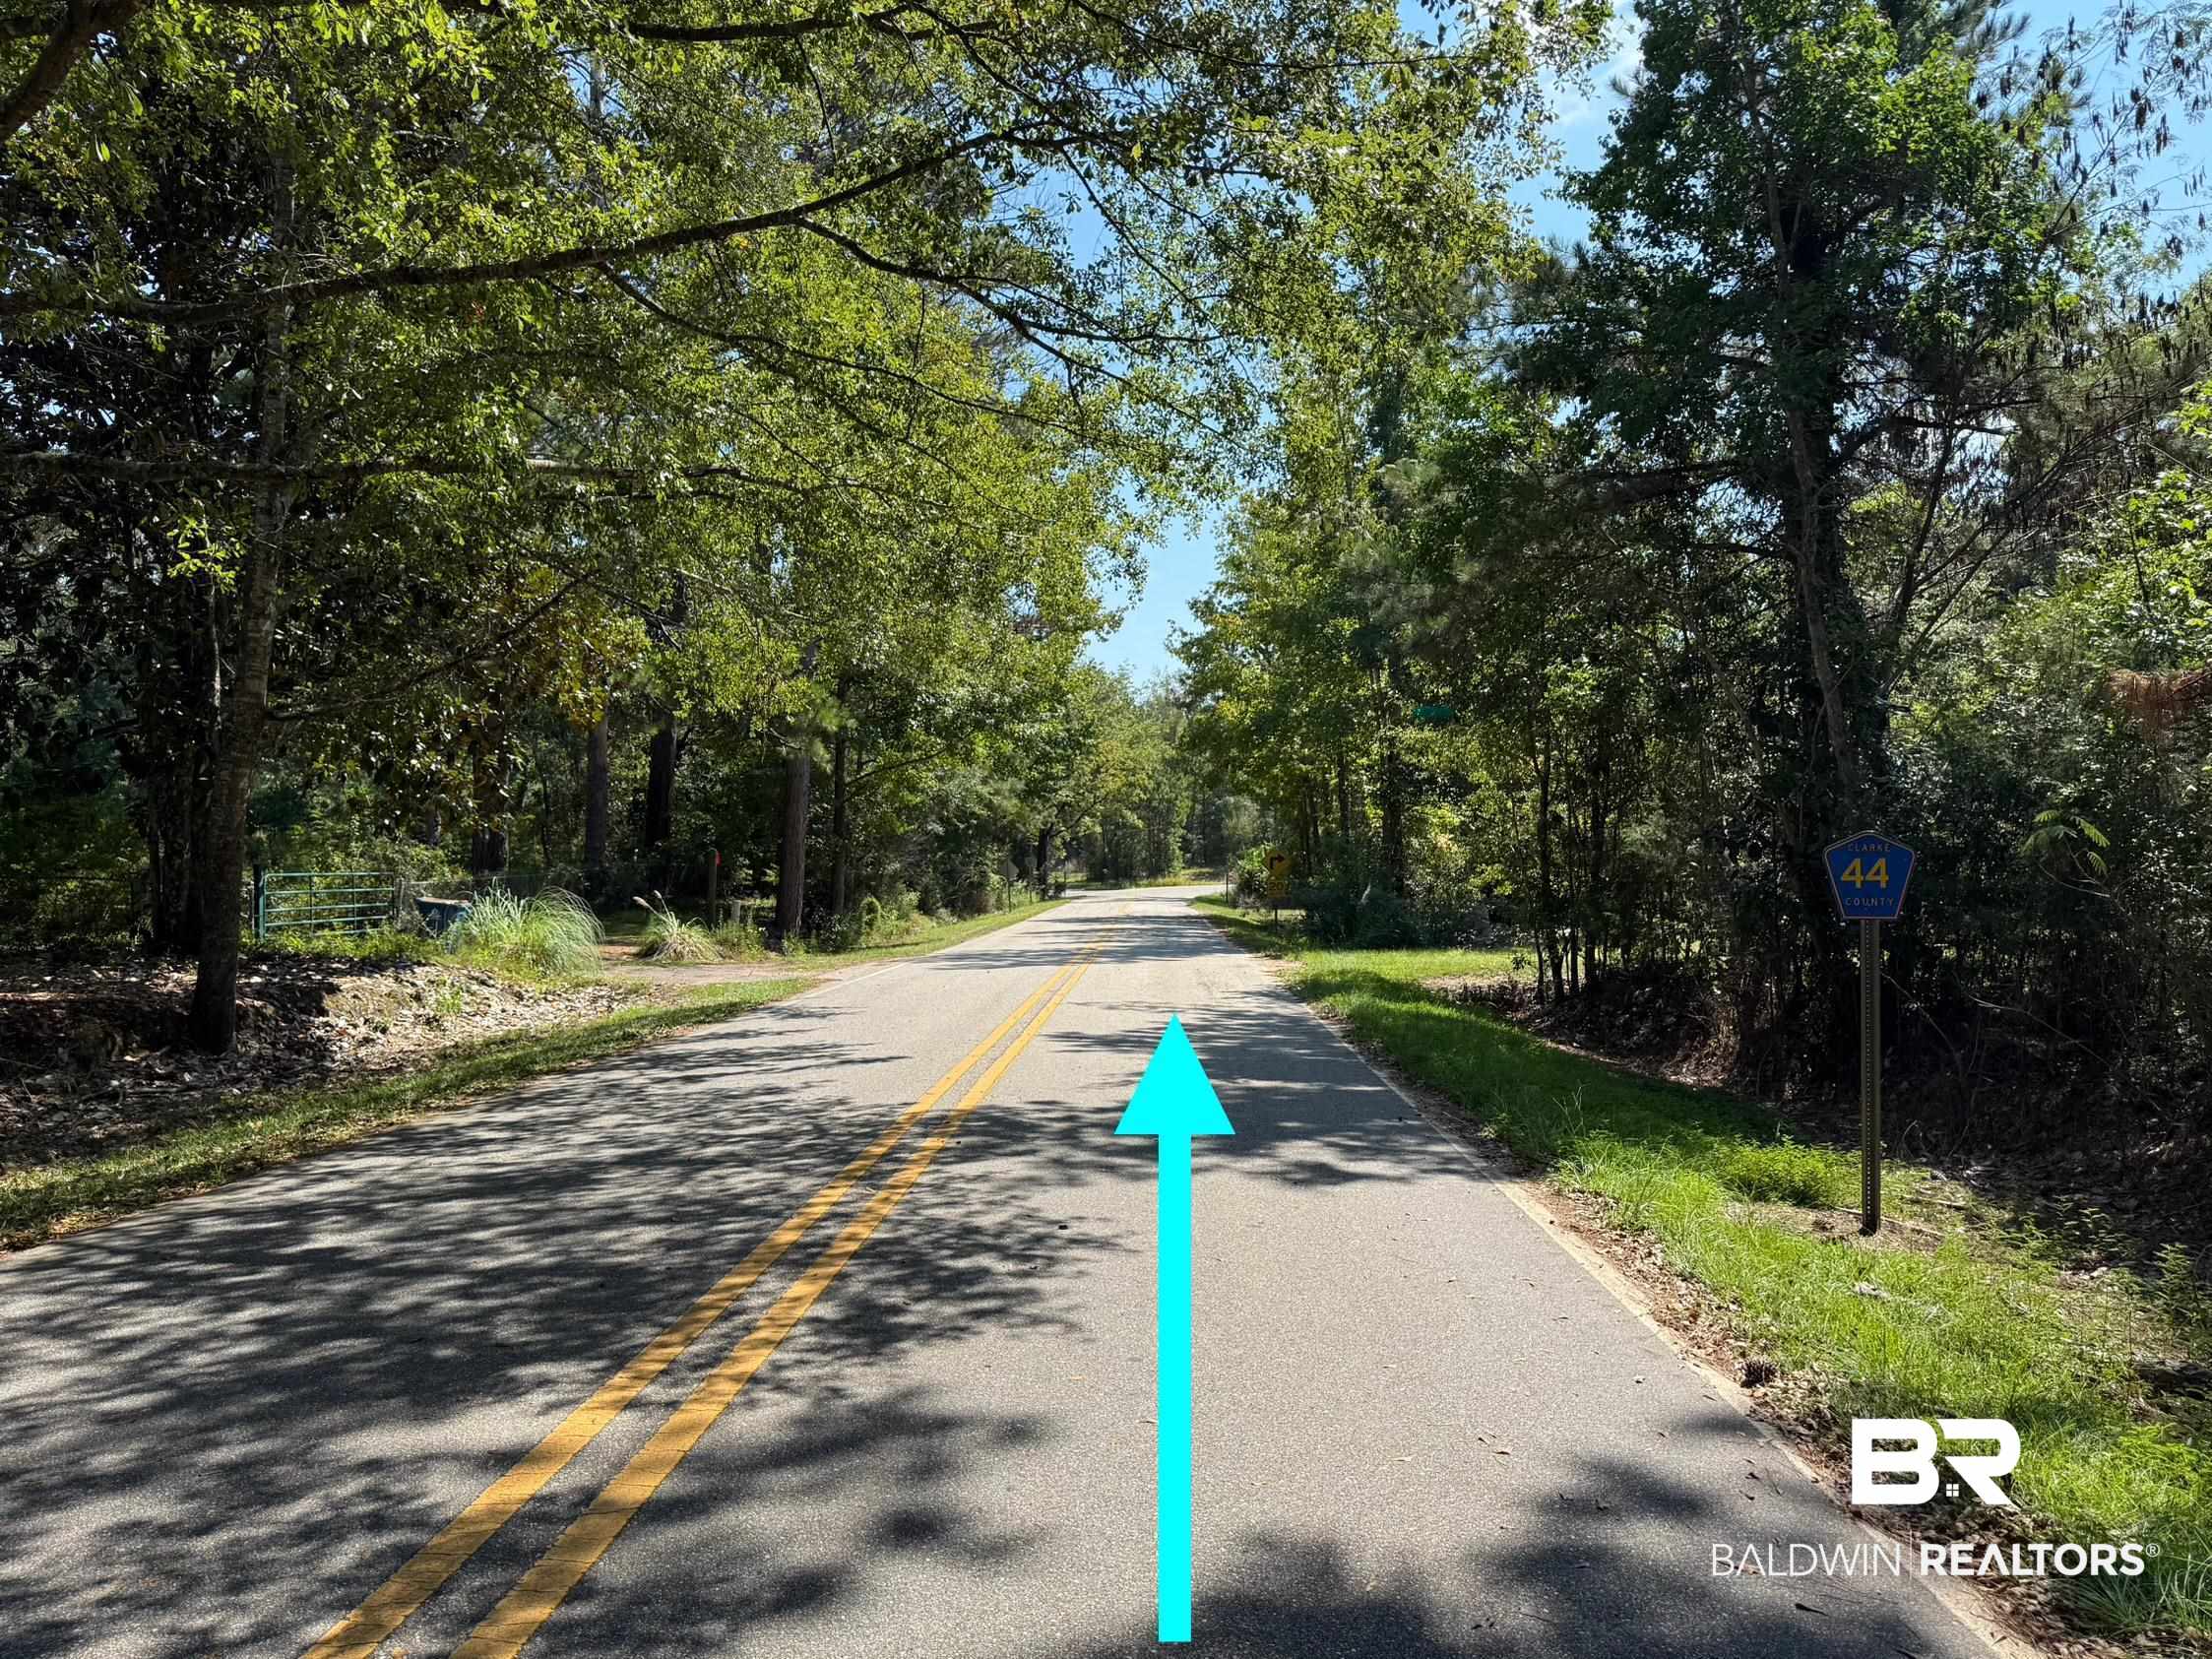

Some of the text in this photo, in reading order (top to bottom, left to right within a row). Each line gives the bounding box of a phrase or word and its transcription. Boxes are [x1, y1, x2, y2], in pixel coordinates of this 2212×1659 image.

[1847, 843, 1890, 852] CLARKE
[1841, 858, 1889, 889] 44
[1269, 882, 1284, 891] 20
[1845, 897, 1894, 906] COUNTY
